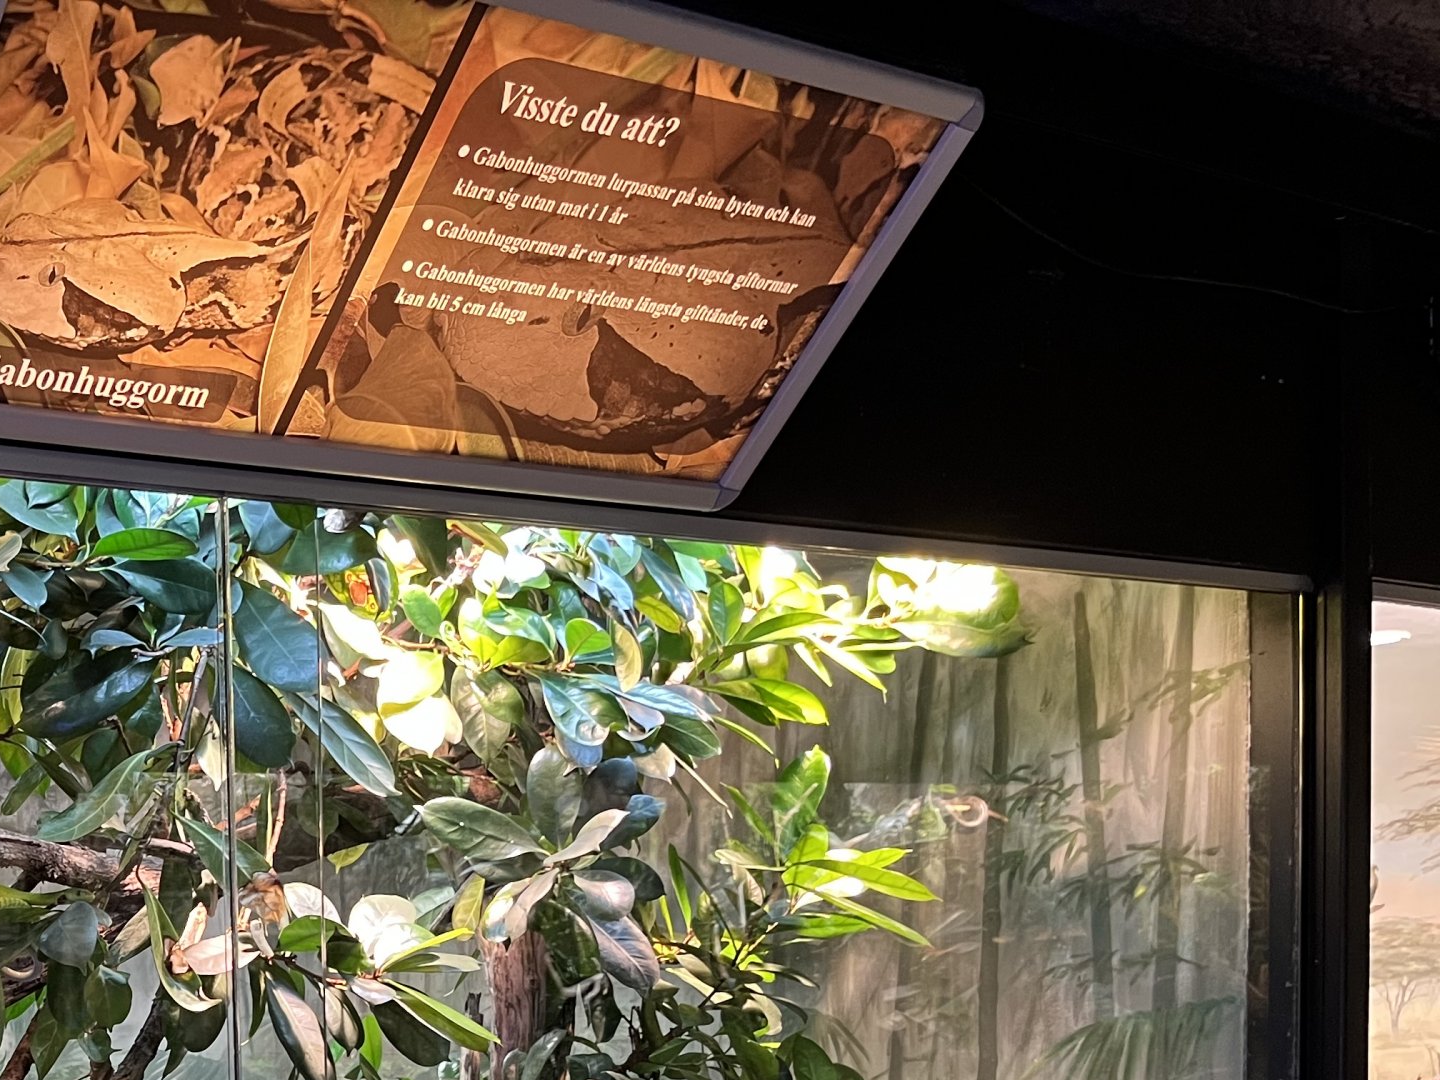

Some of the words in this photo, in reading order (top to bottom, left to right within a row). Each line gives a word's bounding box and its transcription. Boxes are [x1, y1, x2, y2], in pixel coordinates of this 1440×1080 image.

[500, 81, 578, 128] Visste
[580, 101, 620, 136] du
[620, 115, 680, 148] att?
[452, 178, 496, 202] klara
[496, 187, 521, 211] sig
[521, 194, 556, 213] utan
[556, 201, 589, 219] mat
[587, 202, 599, 220] i
[596, 204, 610, 222] 1
[608, 206, 629, 225] år
[473, 146, 607, 188] Gabonhuggormen
[607, 172, 676, 202] lurpassar
[672, 187, 698, 208] på
[694, 191, 726, 211] sina
[725, 195, 765, 218] byten
[764, 205, 790, 223] och
[789, 207, 817, 228] kan
[436, 220, 568, 256] Gabonhuggormen
[567, 243, 587, 261] är
[587, 250, 609, 264] en
[607, 253, 626, 267] av
[627, 254, 686, 277] världens
[685, 263, 735, 286] tyngsta
[731, 271, 799, 295] giftormar
[394, 287, 426, 308] kan
[426, 292, 448, 311] bli
[448, 296, 464, 312] 5
[462, 301, 486, 316] cm
[486, 301, 528, 325] långa
[415, 261, 547, 297] Gabonhuggormen
[546, 282, 576, 301] har
[576, 287, 634, 311] världens
[634, 295, 682, 319] längsta
[750, 313, 768, 331] de
